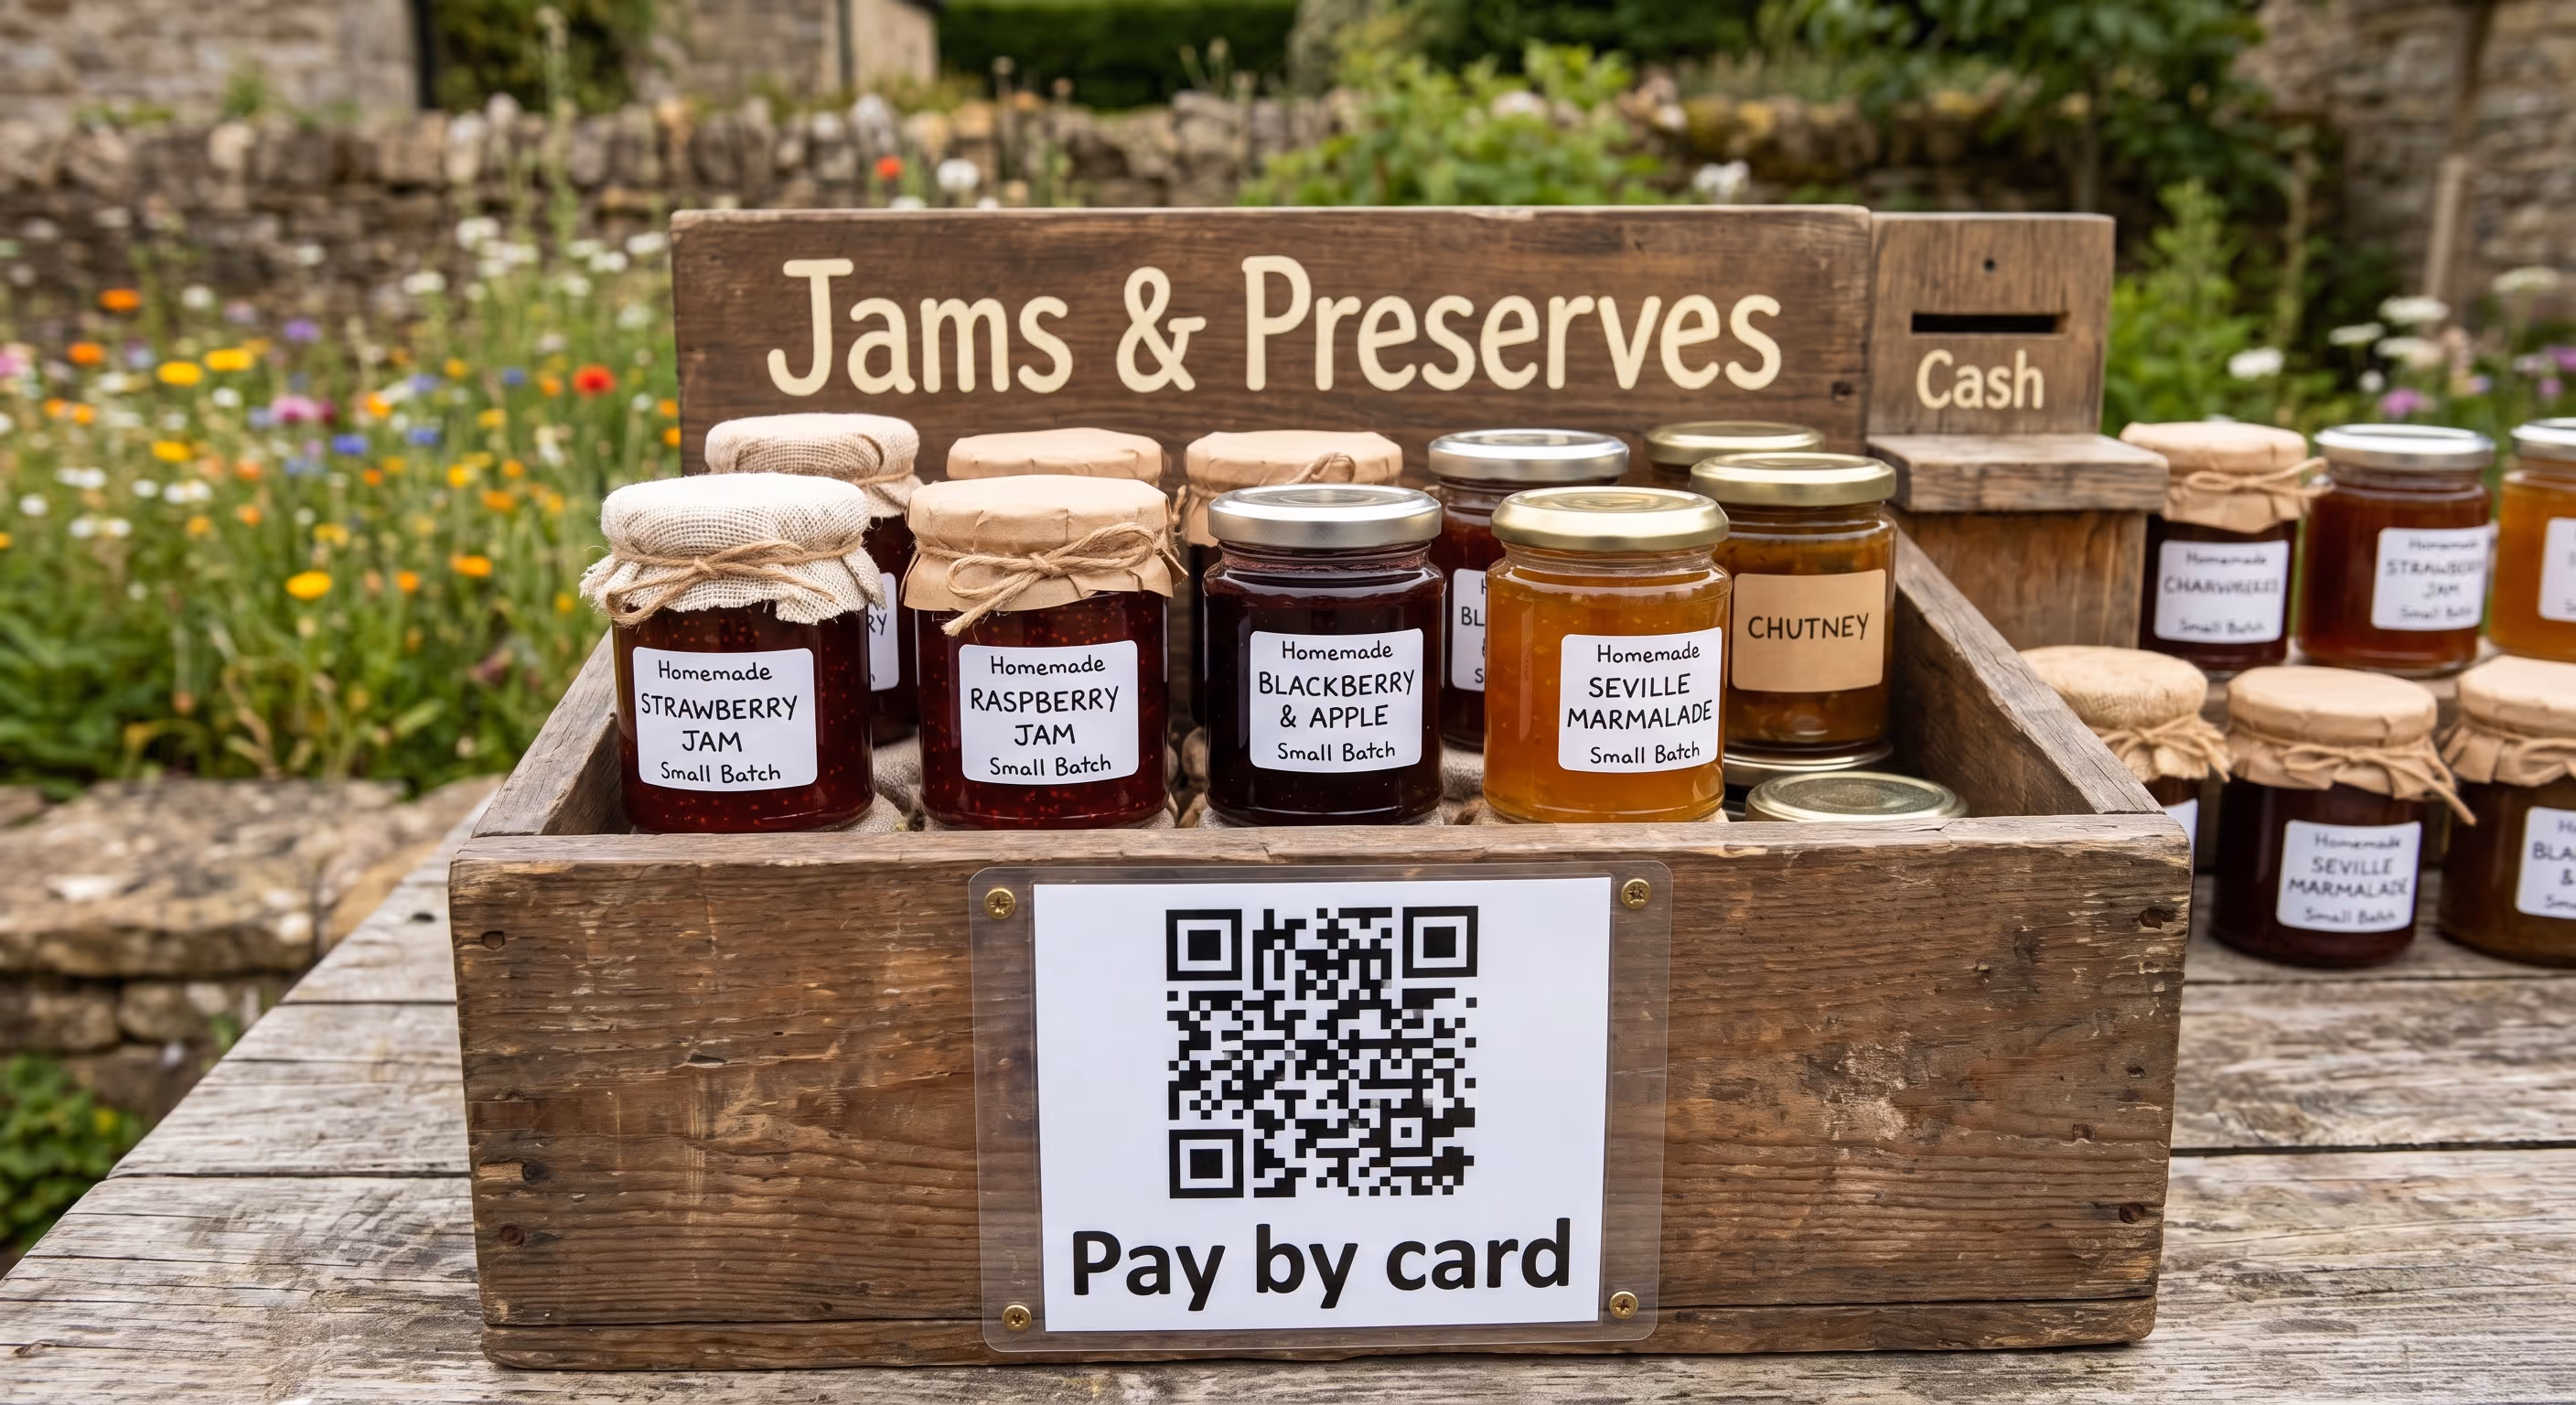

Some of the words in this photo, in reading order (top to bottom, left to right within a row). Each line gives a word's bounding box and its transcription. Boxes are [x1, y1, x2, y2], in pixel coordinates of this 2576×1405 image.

[767, 258, 1073, 397] Jams
[1115, 266, 1204, 393] &
[1240, 254, 1782, 391] Preserves
[1916, 349, 2045, 410] Cash
[1746, 612, 1869, 640] CHUTNEY
[1282, 639, 1393, 661] Homemade
[1597, 640, 1701, 664] Homemade
[658, 659, 773, 682] Homemade
[990, 654, 1106, 676] Homemade
[1259, 669, 1415, 698] BLACKBERRY
[1588, 672, 1691, 699] SEVILLE
[640, 692, 798, 721] STRAWBERRY
[971, 685, 1119, 714] RASPBERRY
[1280, 703, 1297, 728] &
[1308, 703, 1389, 729] APPLE
[1566, 699, 1712, 730] MARMALADE
[682, 729, 743, 753] JAM
[1014, 723, 1076, 746] JAM
[1277, 742, 1332, 762] Small
[1342, 740, 1396, 763] Batch
[1590, 745, 1645, 765] Small
[1655, 740, 1701, 764] Batch
[660, 761, 711, 783] Small
[720, 763, 781, 784] Batch
[989, 756, 1046, 777] Small
[1055, 753, 1111, 777] Batch
[2312, 856, 2395, 876] SEVILLE
[1072, 1230, 1226, 1312] Pay
[1256, 1223, 1359, 1310] by
[1386, 1217, 1571, 1292] card
